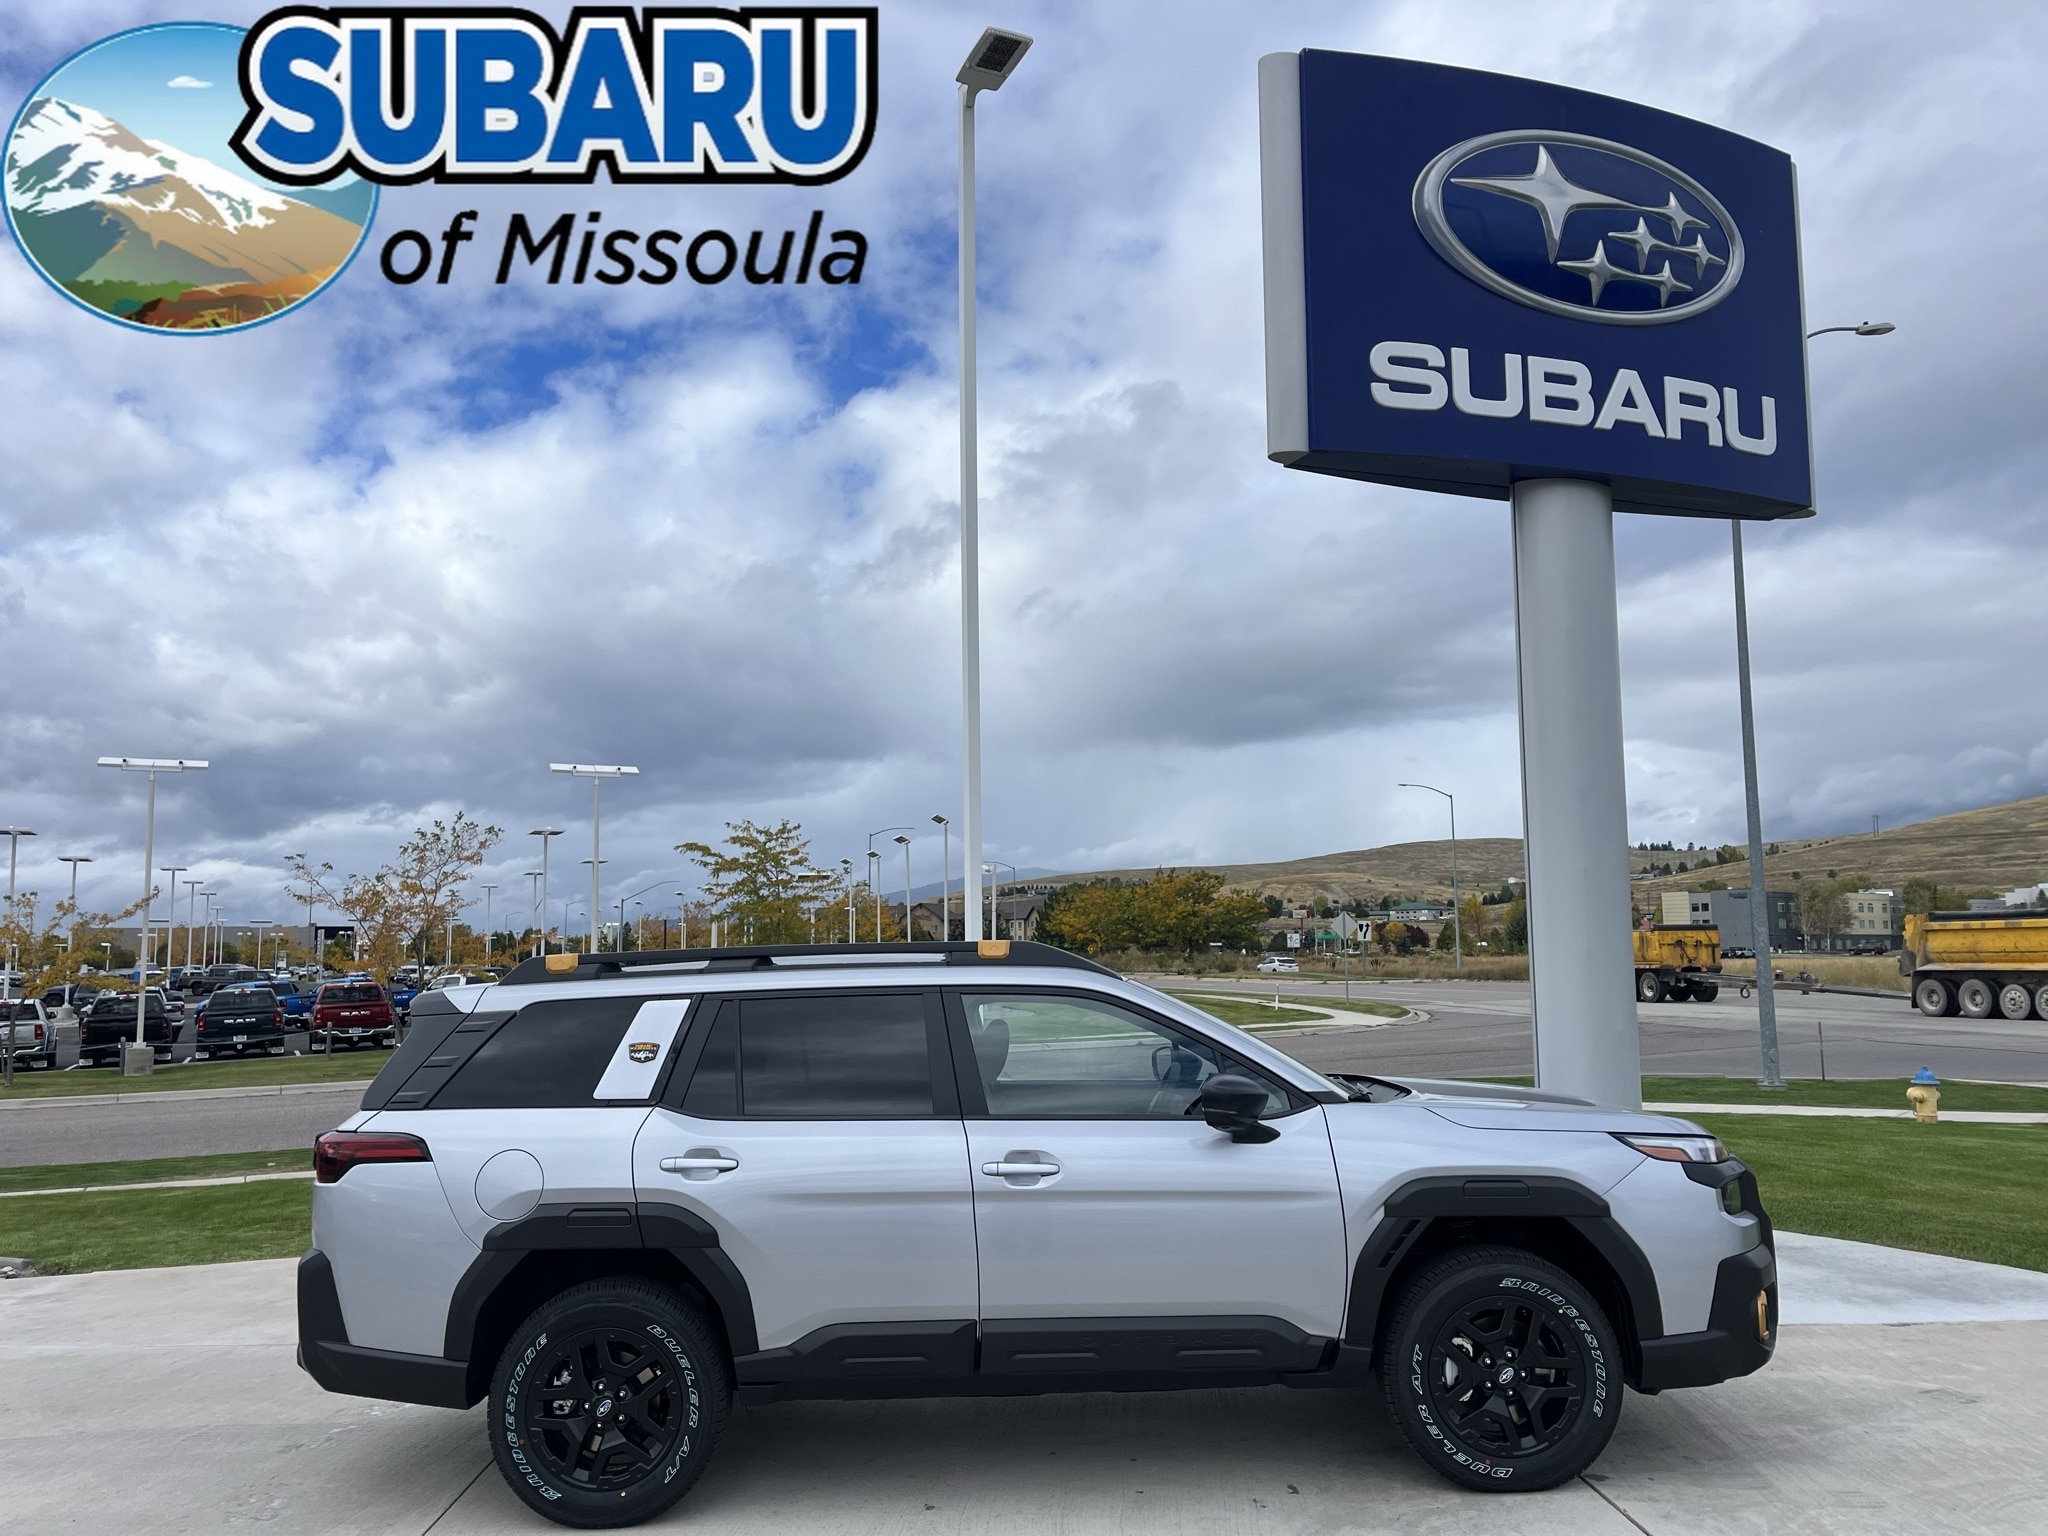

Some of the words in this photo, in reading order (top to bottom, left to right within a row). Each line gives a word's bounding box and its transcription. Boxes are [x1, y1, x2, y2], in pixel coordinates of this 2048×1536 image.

[1369, 340, 1778, 457] SUBARU
[646, 1324, 699, 1429] DUELER
[1411, 1343, 1424, 1395] A/T
[1499, 1277, 1607, 1418] BRIDGESTONE
[505, 1333, 562, 1500] BRIDGESTONE
[1417, 1403, 1514, 1478] DUELER
